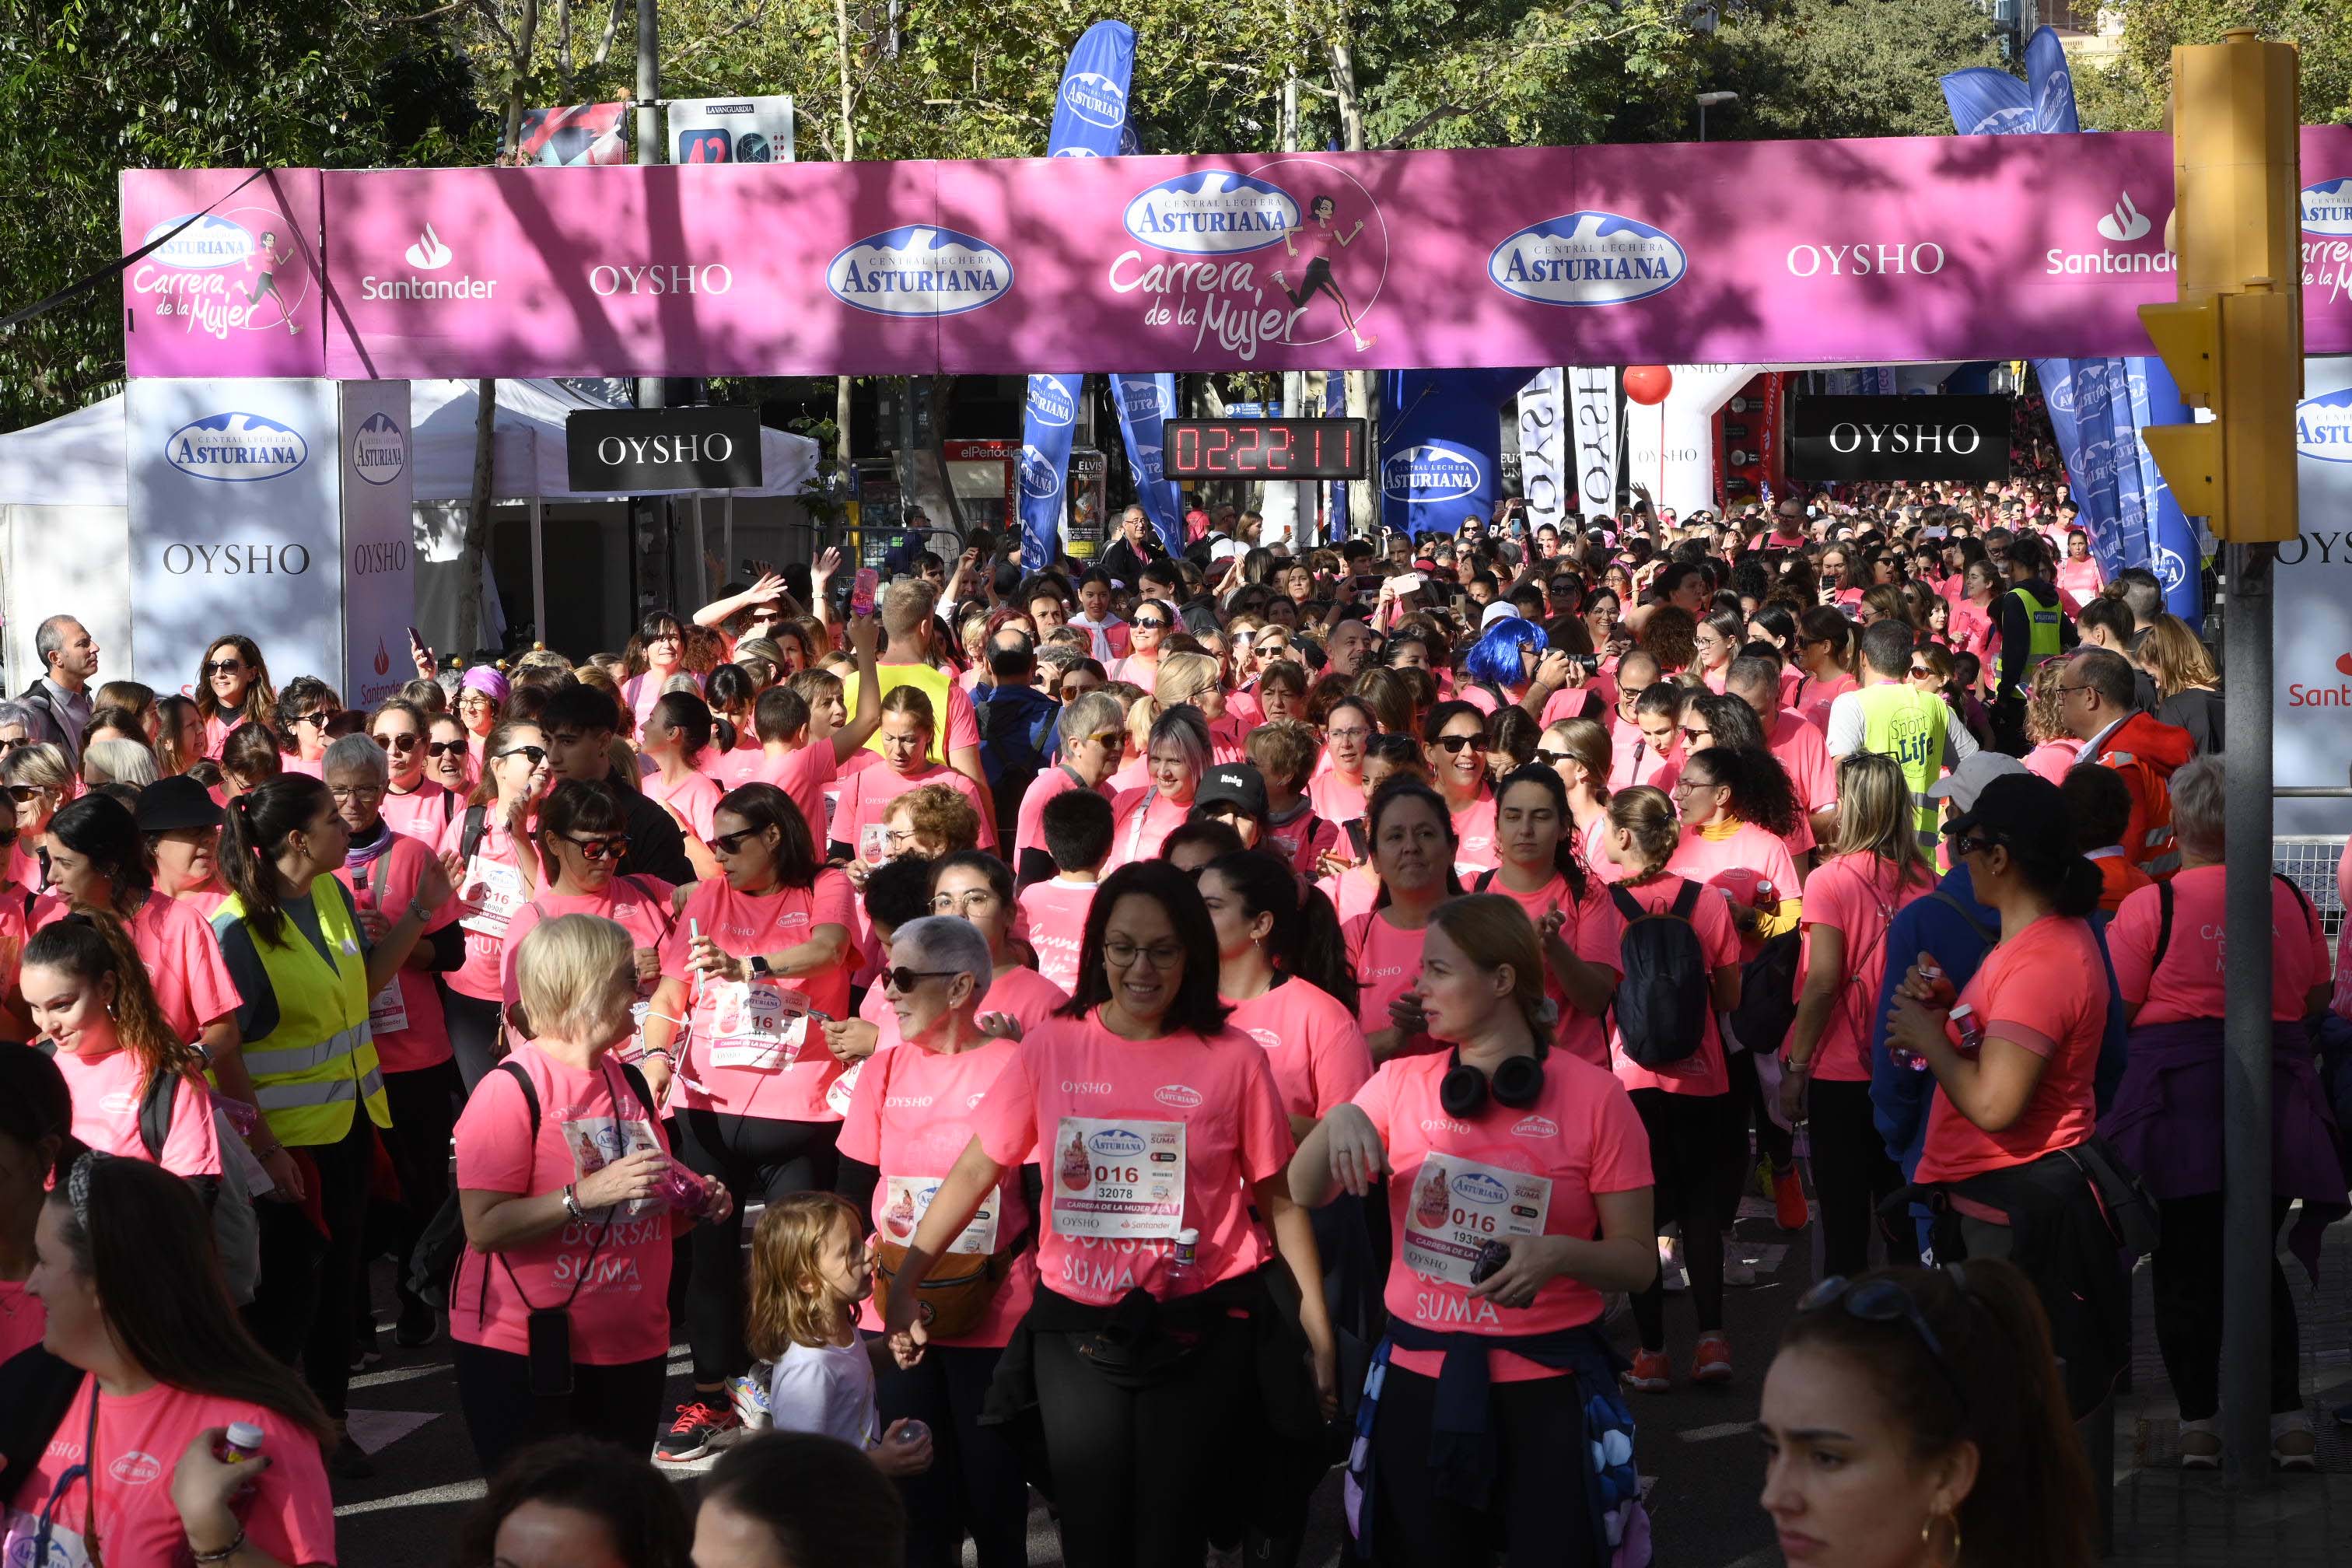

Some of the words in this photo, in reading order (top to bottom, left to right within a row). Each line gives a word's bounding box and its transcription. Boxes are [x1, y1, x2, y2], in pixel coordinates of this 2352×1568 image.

[1164, 199, 1220, 208] CENTRAL
[1226, 198, 1282, 207] LECHERA
[1137, 202, 1285, 233] ASTURIANA
[870, 248, 928, 258] CENTRAL
[934, 248, 992, 257] LECHERA
[1534, 244, 1594, 254] CENTRAL
[1602, 243, 1664, 252] LECHERA
[1787, 243, 1945, 277] OYSHO
[841, 252, 999, 293] ASTURIANA
[1108, 250, 1255, 293] Carrera
[1503, 248, 1671, 282] ASTURIANA
[2319, 265, 2332, 285] la
[134, 264, 226, 294] Carrera
[362, 275, 497, 300] Santander
[590, 264, 733, 296] OYSHO
[156, 295, 173, 316] de
[177, 297, 189, 316] la
[187, 292, 260, 340] Mujer
[1144, 295, 1171, 326] de
[1177, 295, 1196, 326] la
[1193, 288, 1308, 361] Mujer
[177, 437, 298, 464] ASTURIANA
[597, 432, 733, 465] OYSHO
[1177, 427, 1350, 471] 02:22:11
[1829, 422, 1979, 454] OYSHO
[357, 439, 402, 467] ASTURIANA
[1078, 460, 1102, 471] ELVIS
[1638, 448, 1697, 463] OYSHO
[1384, 468, 1472, 490] ASTURIANA
[163, 543, 310, 575] OYSHO
[354, 541, 406, 576] OYSHO
[2289, 684, 2351, 707] Sant
[1891, 715, 1928, 740] Sport
[1899, 732, 1934, 766] Life
[1062, 1081, 1112, 1095] OYSHO
[1158, 1089, 1199, 1104] ASTURIANA
[885, 1095, 933, 1108] OYSHO
[1420, 1119, 1471, 1135] OYSHO
[1515, 1124, 1555, 1135] ASTURIANA
[1093, 1139, 1141, 1151] ASTURIANA
[1094, 1166, 1139, 1183] 016
[1098, 1188, 1132, 1199] 32078
[1455, 1179, 1504, 1201] ASTURIANA
[1514, 1189, 1541, 1200] SUMA
[1067, 1201, 1099, 1209] CARRERA
[561, 1218, 662, 1246] DORSAL
[1062, 1217, 1100, 1228] OYSHO
[1132, 1220, 1170, 1230] Santander
[1452, 1208, 1496, 1233] 016
[1416, 1237, 1451, 1252] CARRERA
[554, 1254, 640, 1283] SUMA
[1062, 1254, 1136, 1291] SUMA
[1409, 1251, 1448, 1271] OYSHO
[1416, 1293, 1500, 1325] SUMA
